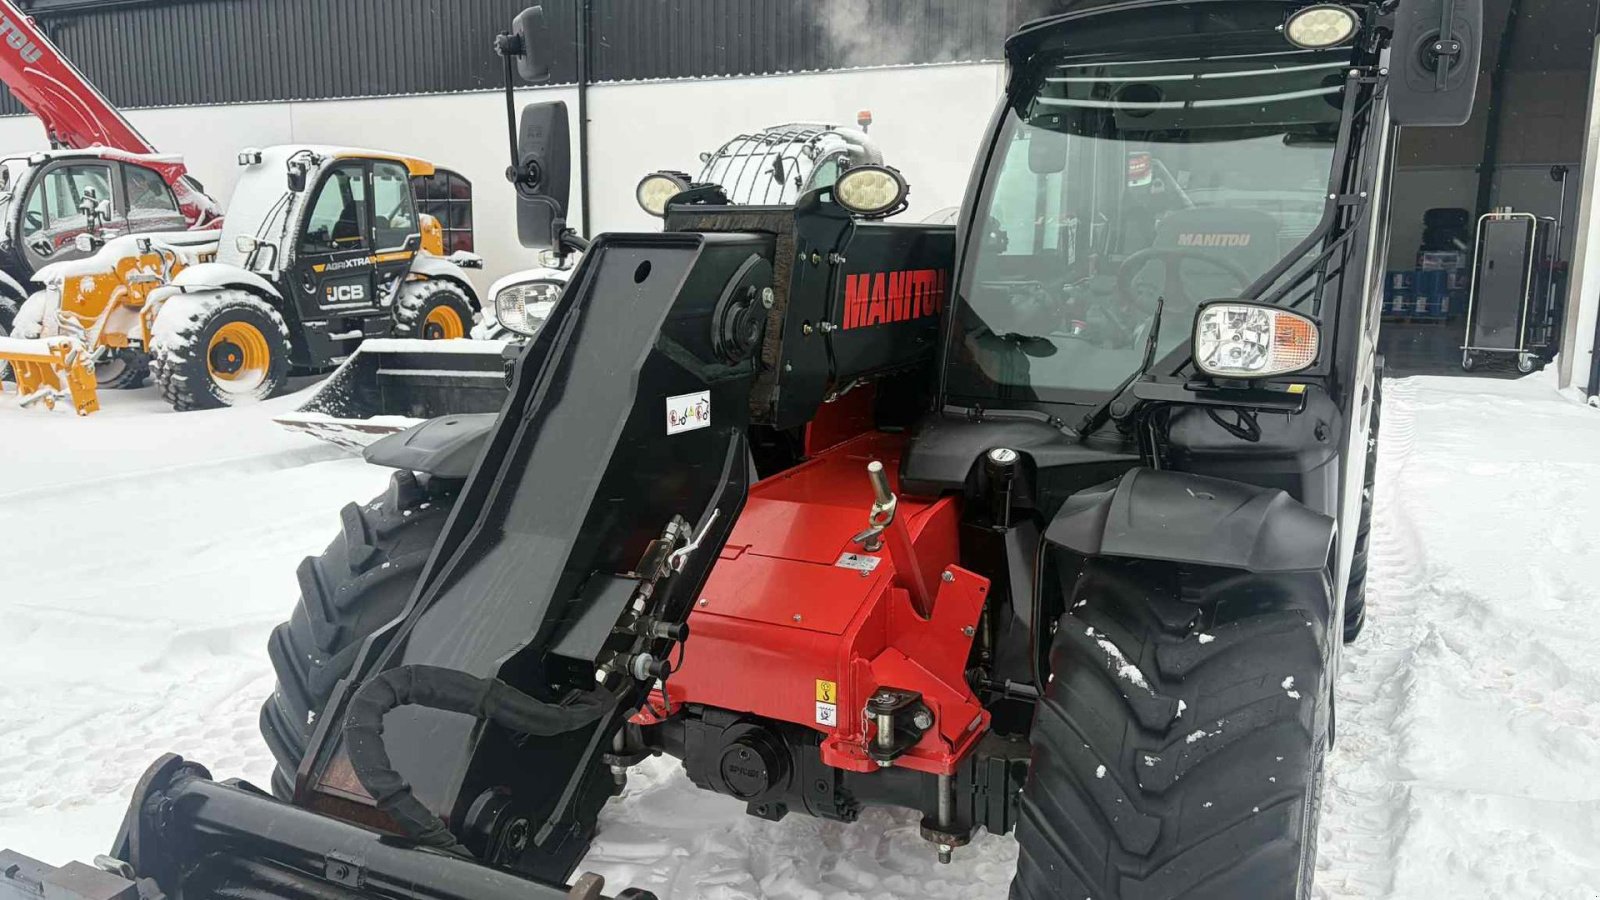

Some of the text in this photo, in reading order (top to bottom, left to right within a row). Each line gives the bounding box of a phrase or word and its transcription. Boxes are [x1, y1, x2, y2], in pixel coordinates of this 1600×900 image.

[0, 10, 43, 63] TOU
[1178, 233, 1250, 246] MANITOU
[326, 285, 364, 301] JCB
